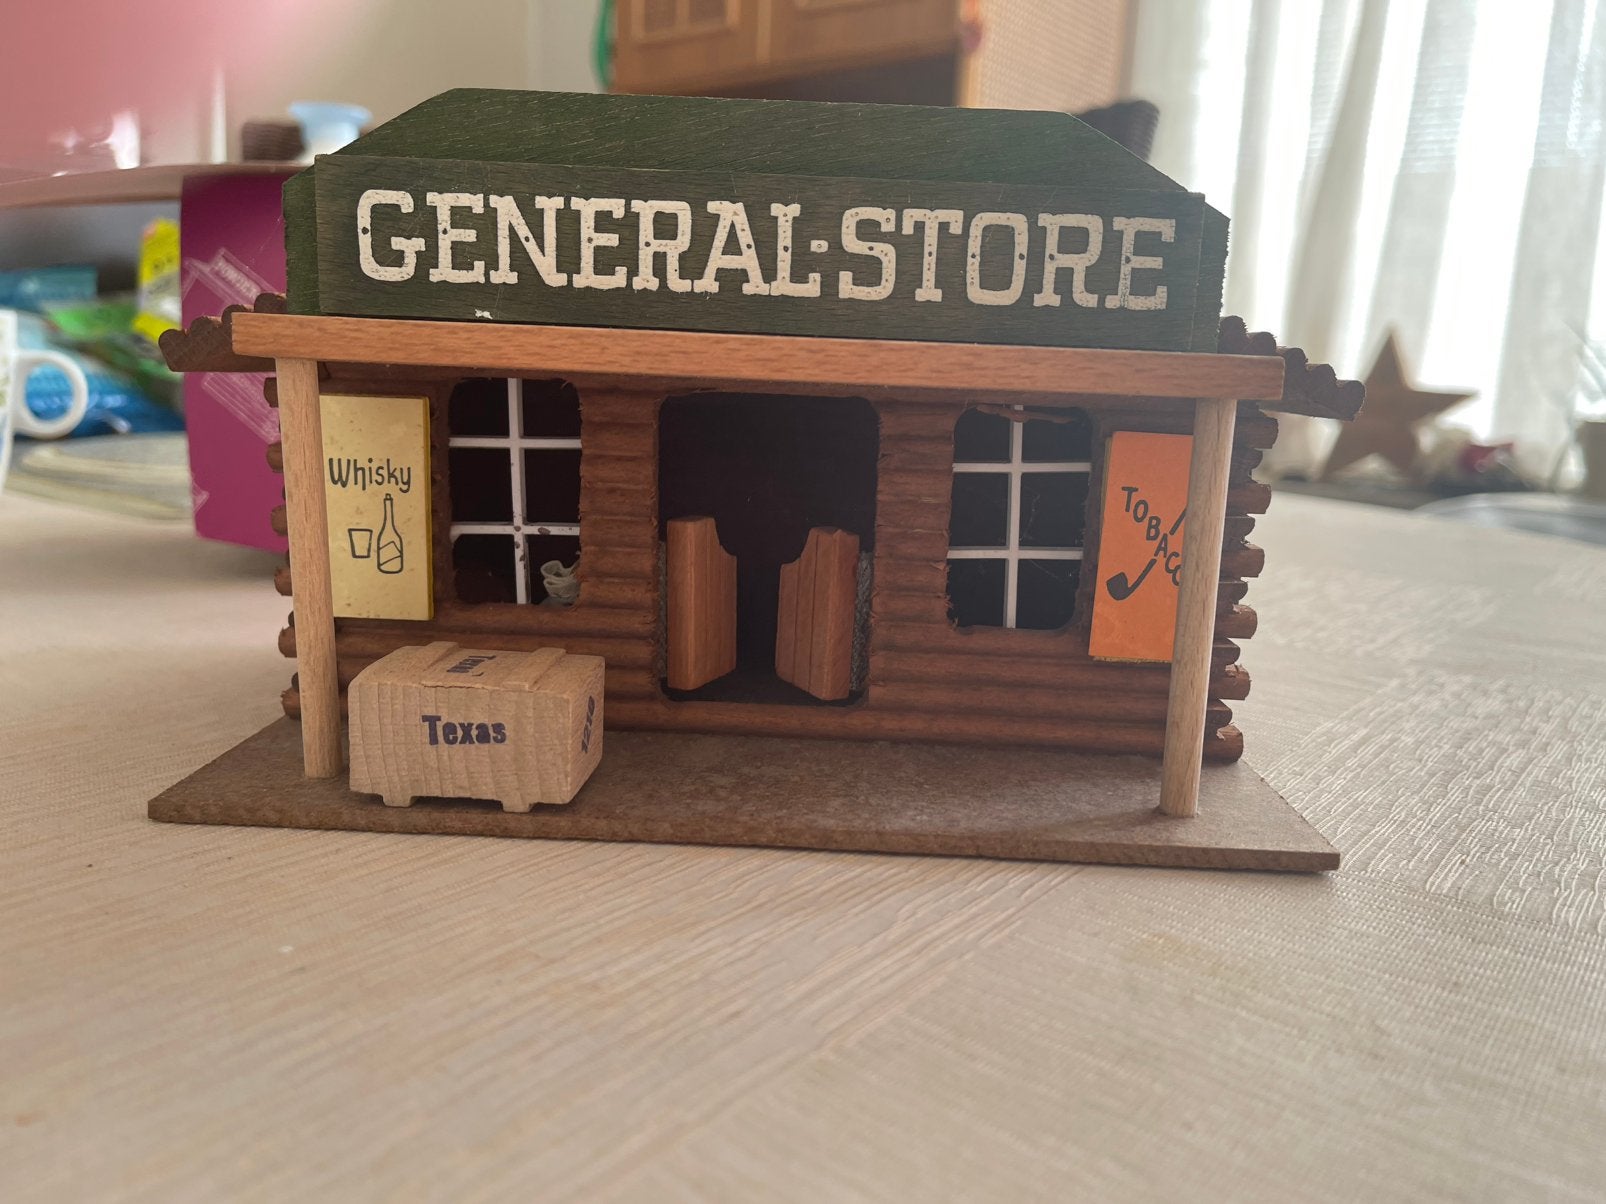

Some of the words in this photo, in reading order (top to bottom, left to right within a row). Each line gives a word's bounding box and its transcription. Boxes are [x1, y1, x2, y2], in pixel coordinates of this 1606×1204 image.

[357, 190, 821, 297] GENERAL
[839, 207, 1175, 310] STORE
[329, 458, 410, 493] Whisky
[422, 715, 506, 745] Texas
